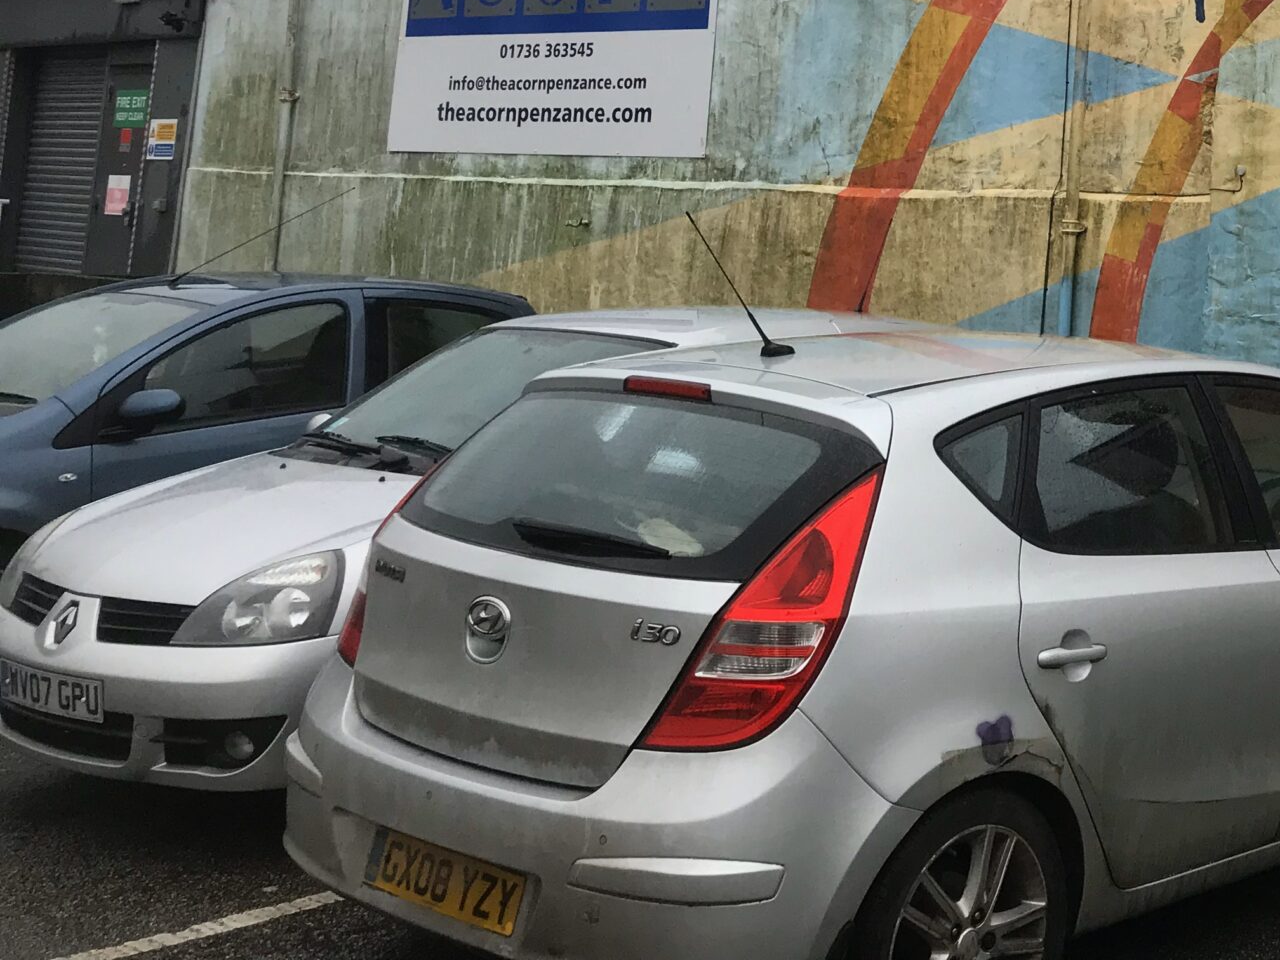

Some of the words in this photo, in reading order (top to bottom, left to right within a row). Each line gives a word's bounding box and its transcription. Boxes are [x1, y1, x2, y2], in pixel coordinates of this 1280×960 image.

[499, 43, 541, 59] 01736
[545, 42, 595, 58] 363545
[448, 75, 648, 94] info@theacornpenzance.com
[116, 96, 131, 108] FIRE
[132, 96, 147, 108] EXIT
[437, 102, 652, 127] theacornpenzance.com
[630, 617, 682, 646] i30
[58, 679, 99, 716] GPU
[458, 865, 519, 925] YZY
